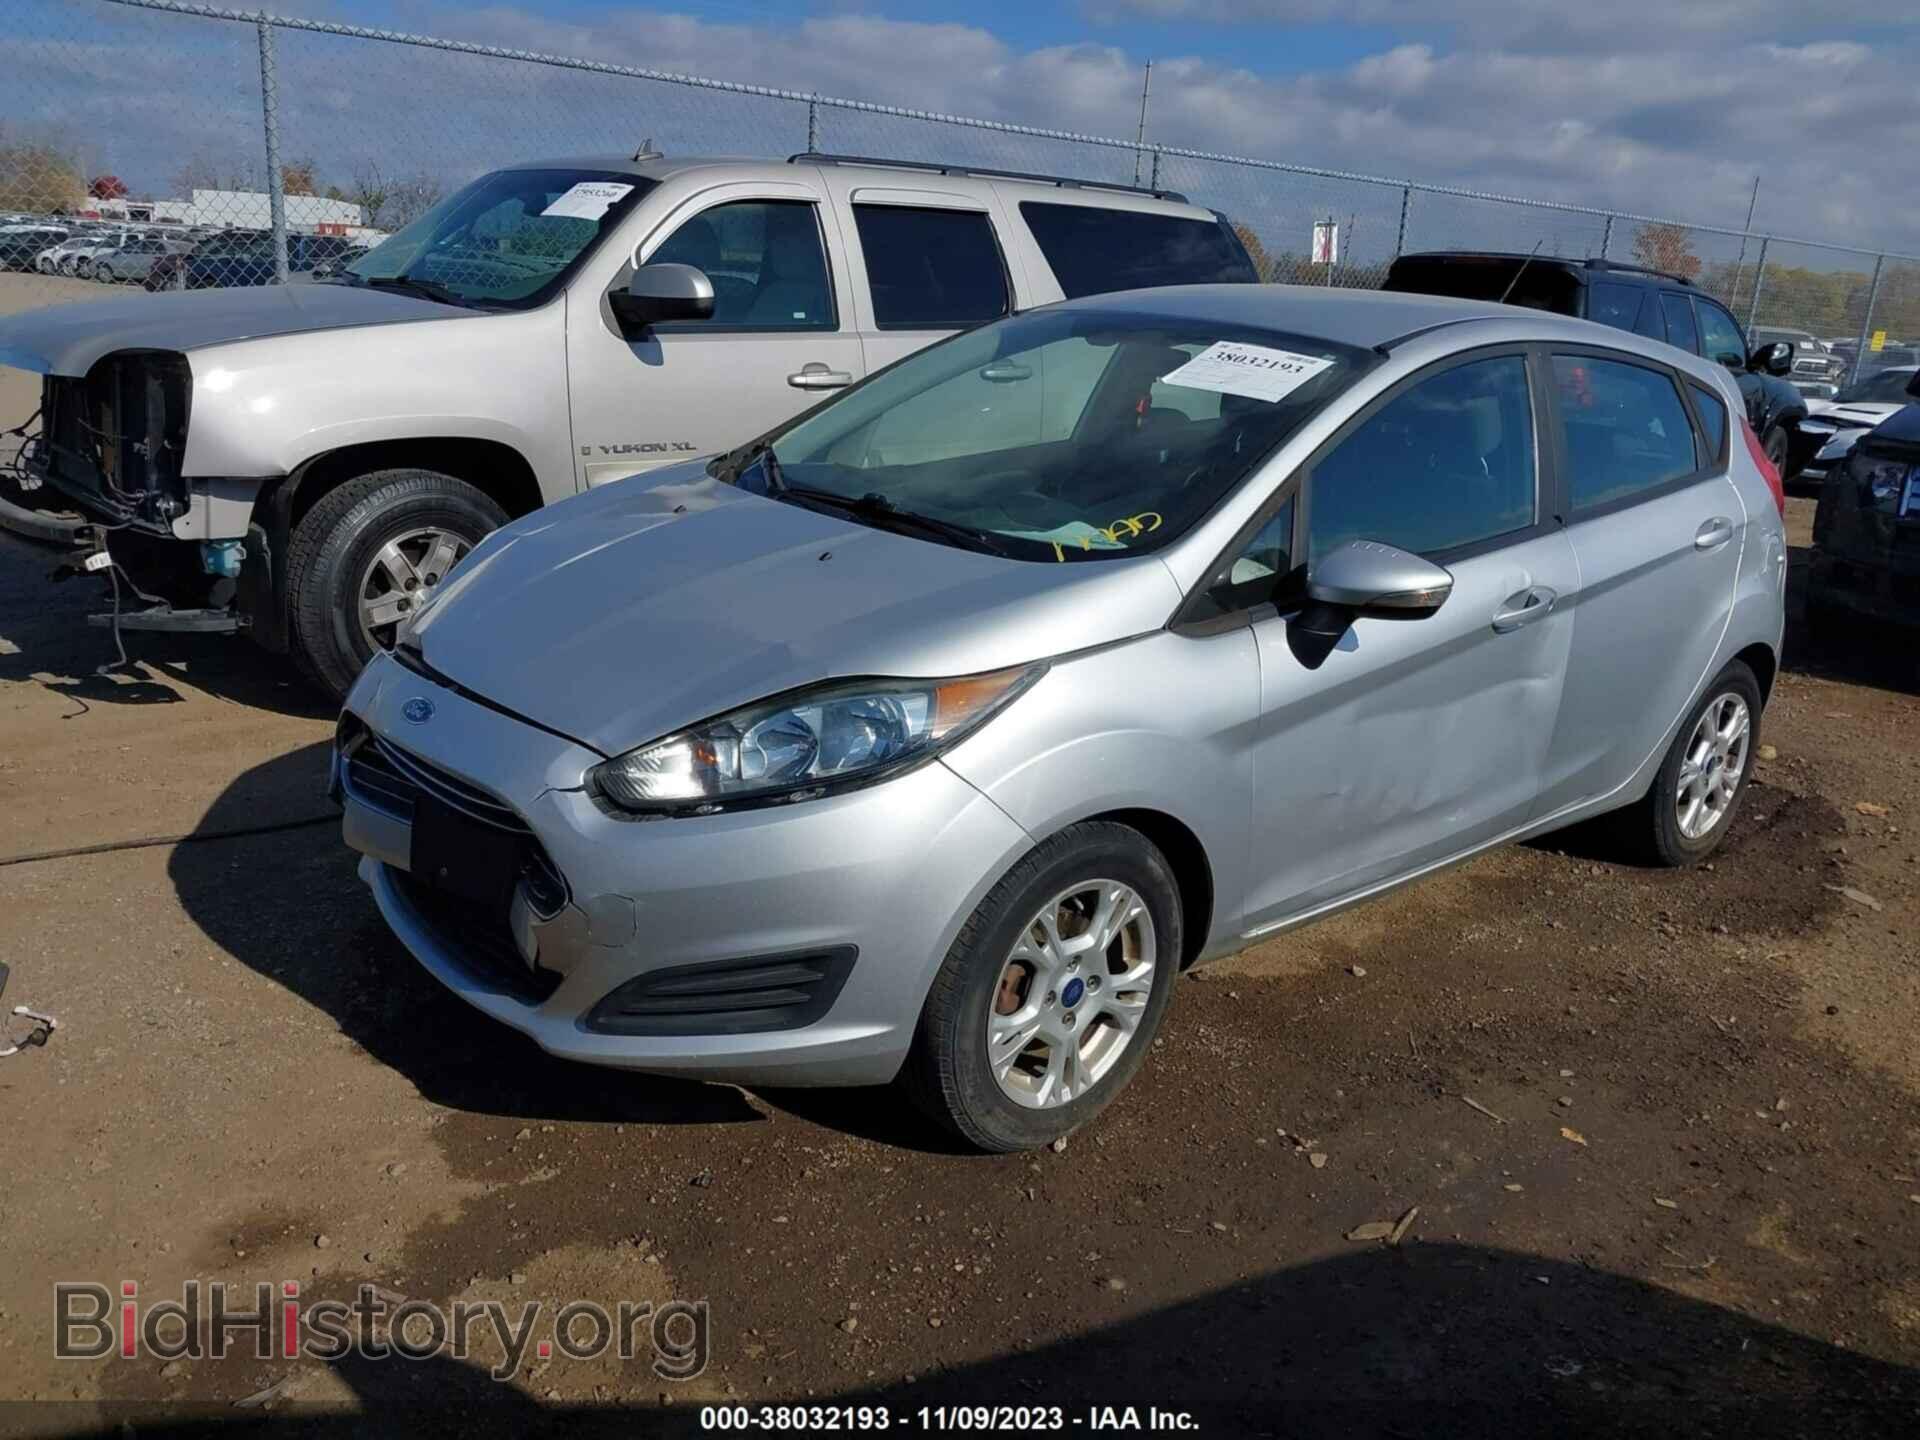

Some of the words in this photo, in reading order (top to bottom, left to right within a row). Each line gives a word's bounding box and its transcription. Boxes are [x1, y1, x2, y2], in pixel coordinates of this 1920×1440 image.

[1209, 351, 1305, 374] 38032193
[598, 442, 667, 455] YUKON
[671, 441, 697, 452] XL
